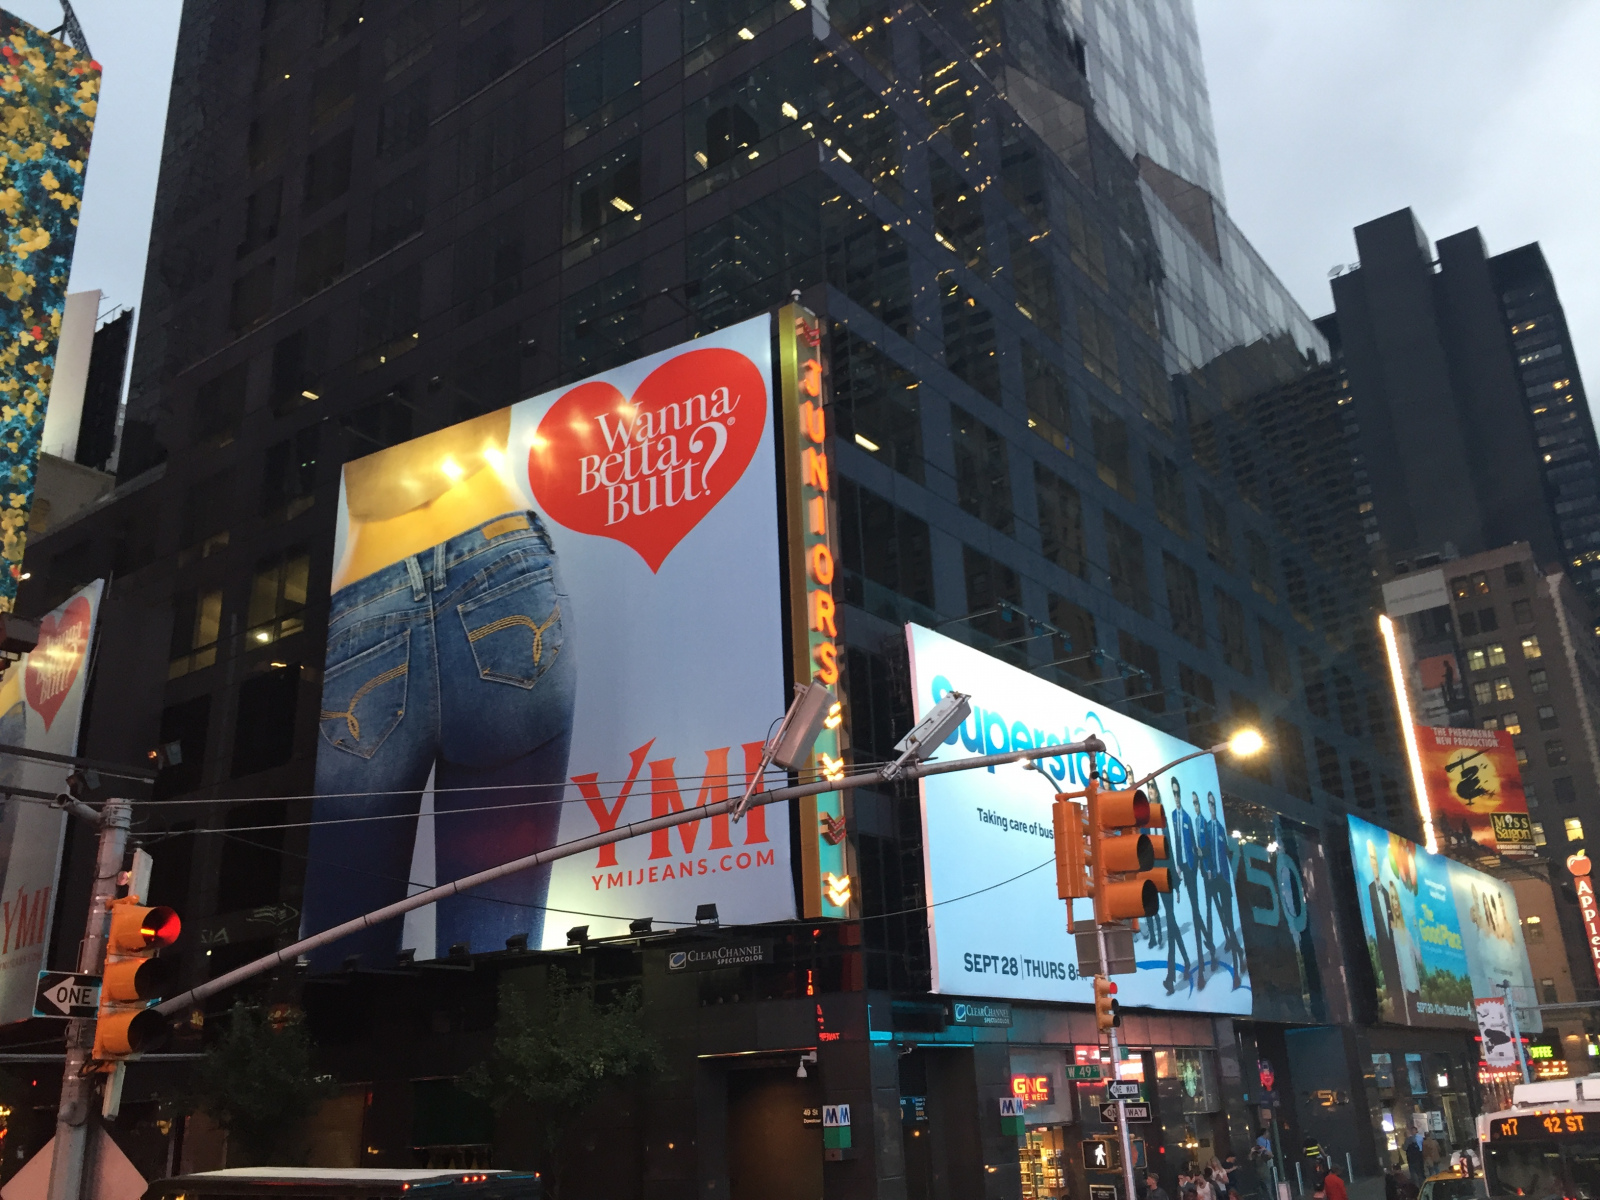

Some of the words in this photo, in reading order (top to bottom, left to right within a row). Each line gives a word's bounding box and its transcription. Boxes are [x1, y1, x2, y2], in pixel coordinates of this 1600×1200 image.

[594, 386, 741, 452] Wanna
[577, 434, 688, 496] Betta
[798, 357, 839, 685] JUNIORS
[977, 807, 1008, 832] Taking
[1009, 818, 1028, 832] care
[1029, 821, 1038, 835] of
[1496, 826, 1532, 843] Saigon
[591, 848, 776, 892] YMIJEANS.COM
[2, 885, 52, 955] YMI
[1577, 880, 1600, 970] Appleb
[717, 954, 763, 966] SPECTACOLOR
[963, 952, 1000, 974] SEPT
[1001, 956, 1019, 976] 28
[1024, 959, 1066, 981] THURS
[56, 986, 92, 1005] ONE
[1068, 1067, 1075, 1077] W
[1079, 1066, 1092, 1077] 49
[1013, 1077, 1048, 1094] GNC
[1112, 1084, 1122, 1094] ONE
[1126, 1084, 1138, 1093] WAY
[1031, 1093, 1048, 1101] WELL
[1107, 1108, 1118, 1117] ON
[1128, 1108, 1144, 1117] WAY
[1501, 1118, 1518, 1136] M7
[1543, 1116, 1563, 1133] 42
[1565, 1115, 1584, 1132] ST
